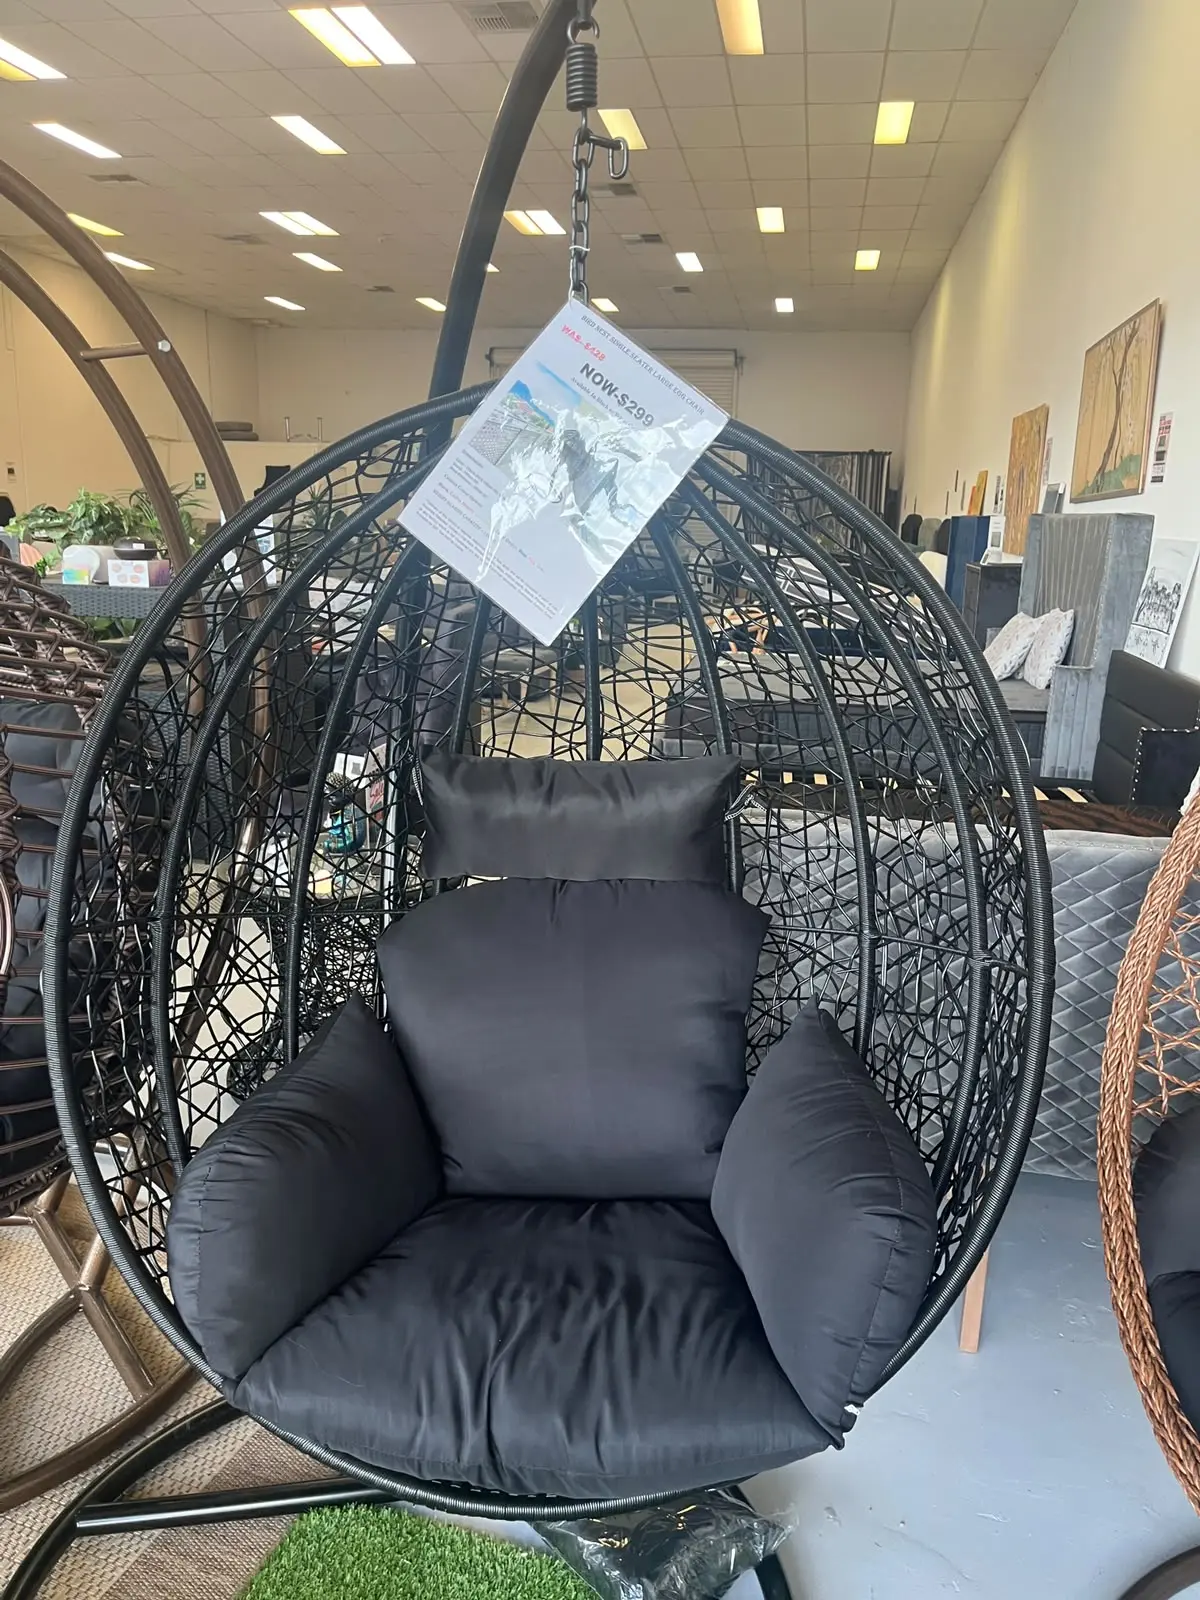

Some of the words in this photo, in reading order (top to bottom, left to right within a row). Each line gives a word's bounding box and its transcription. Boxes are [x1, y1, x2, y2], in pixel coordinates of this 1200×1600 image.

[579, 363, 654, 427] NOW-$299
[581, 315, 595, 329] BIRD
[594, 323, 611, 340] NEST
[609, 333, 631, 355] SINGLE
[628, 352, 654, 374] SEATER
[652, 368, 674, 389] LARGE
[672, 384, 687, 400] EGG
[686, 397, 705, 416] CHAIR
